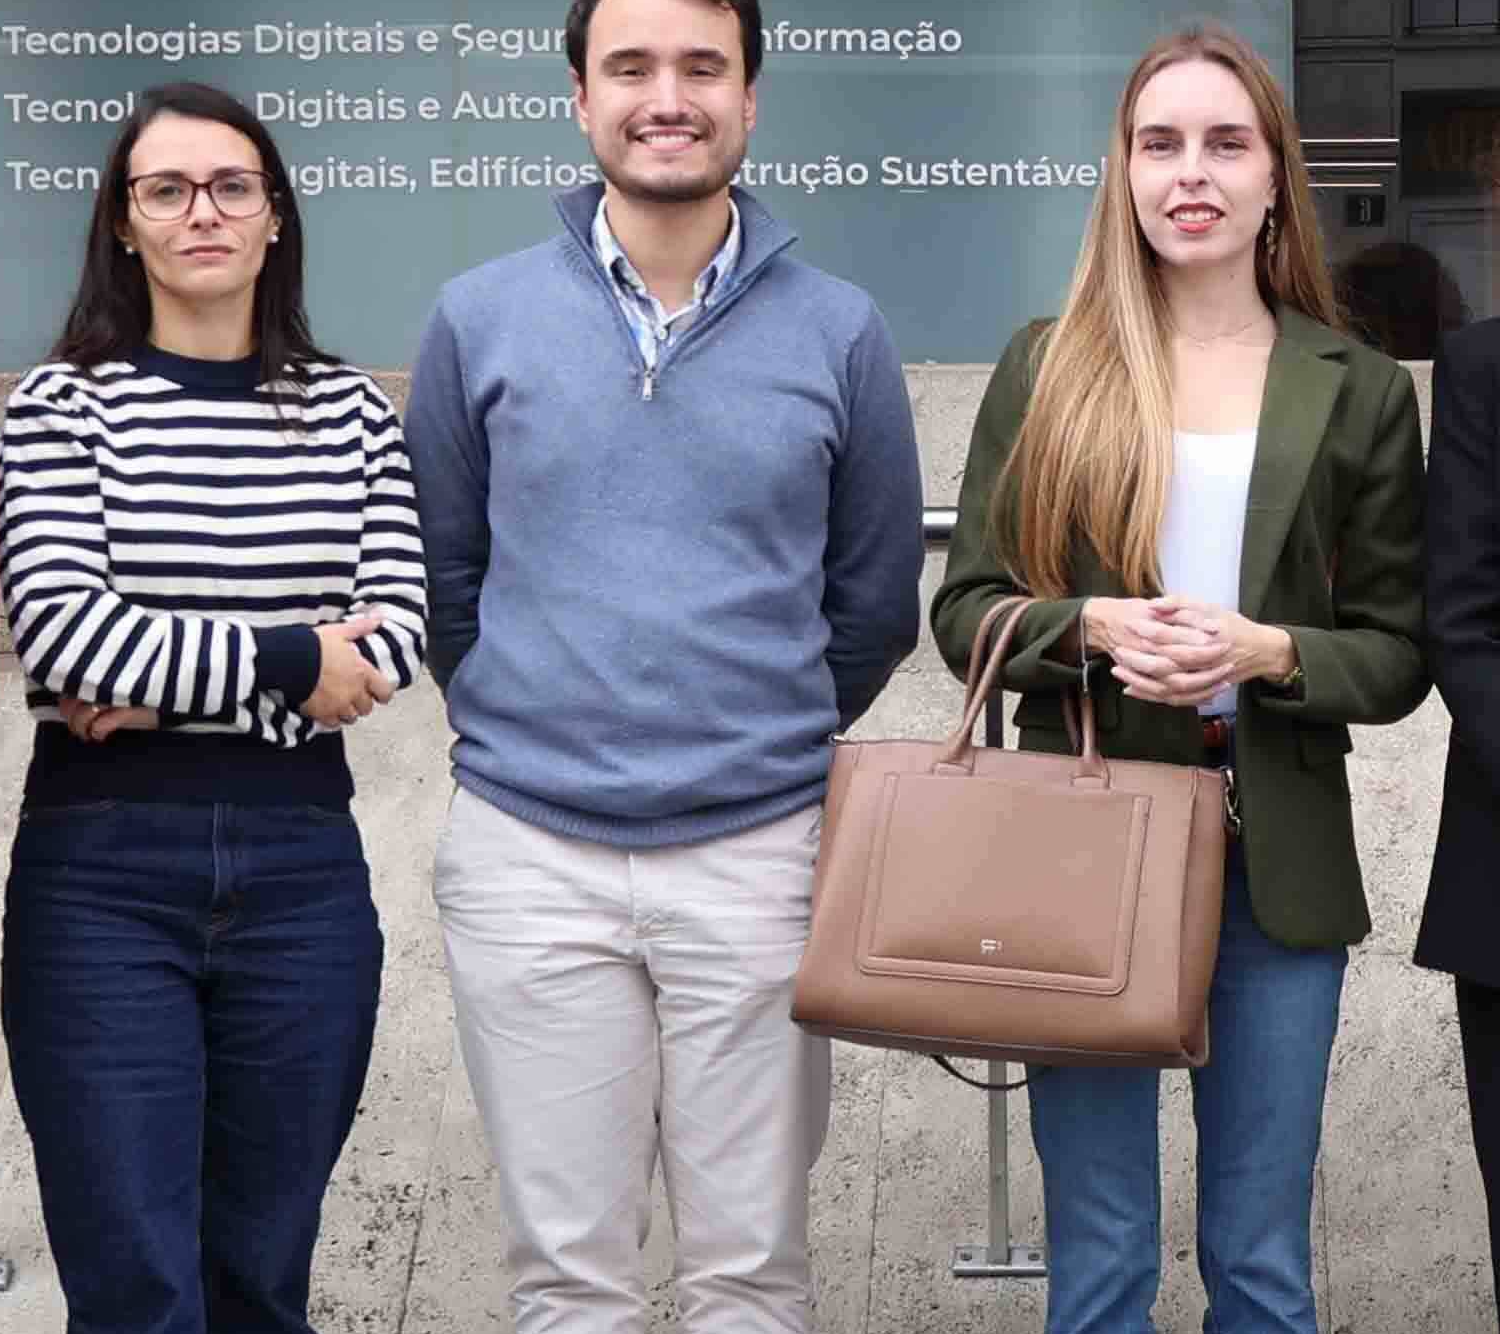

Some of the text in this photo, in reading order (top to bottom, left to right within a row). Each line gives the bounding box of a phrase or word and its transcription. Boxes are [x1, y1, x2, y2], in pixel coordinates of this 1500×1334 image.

[1, 21, 963, 62] Tecnologias Digitais e Segur nformação
[3, 89, 580, 129] Tecnol Digitais e Autom
[429, 154, 596, 188] Edifícios
[728, 155, 870, 194] trução
